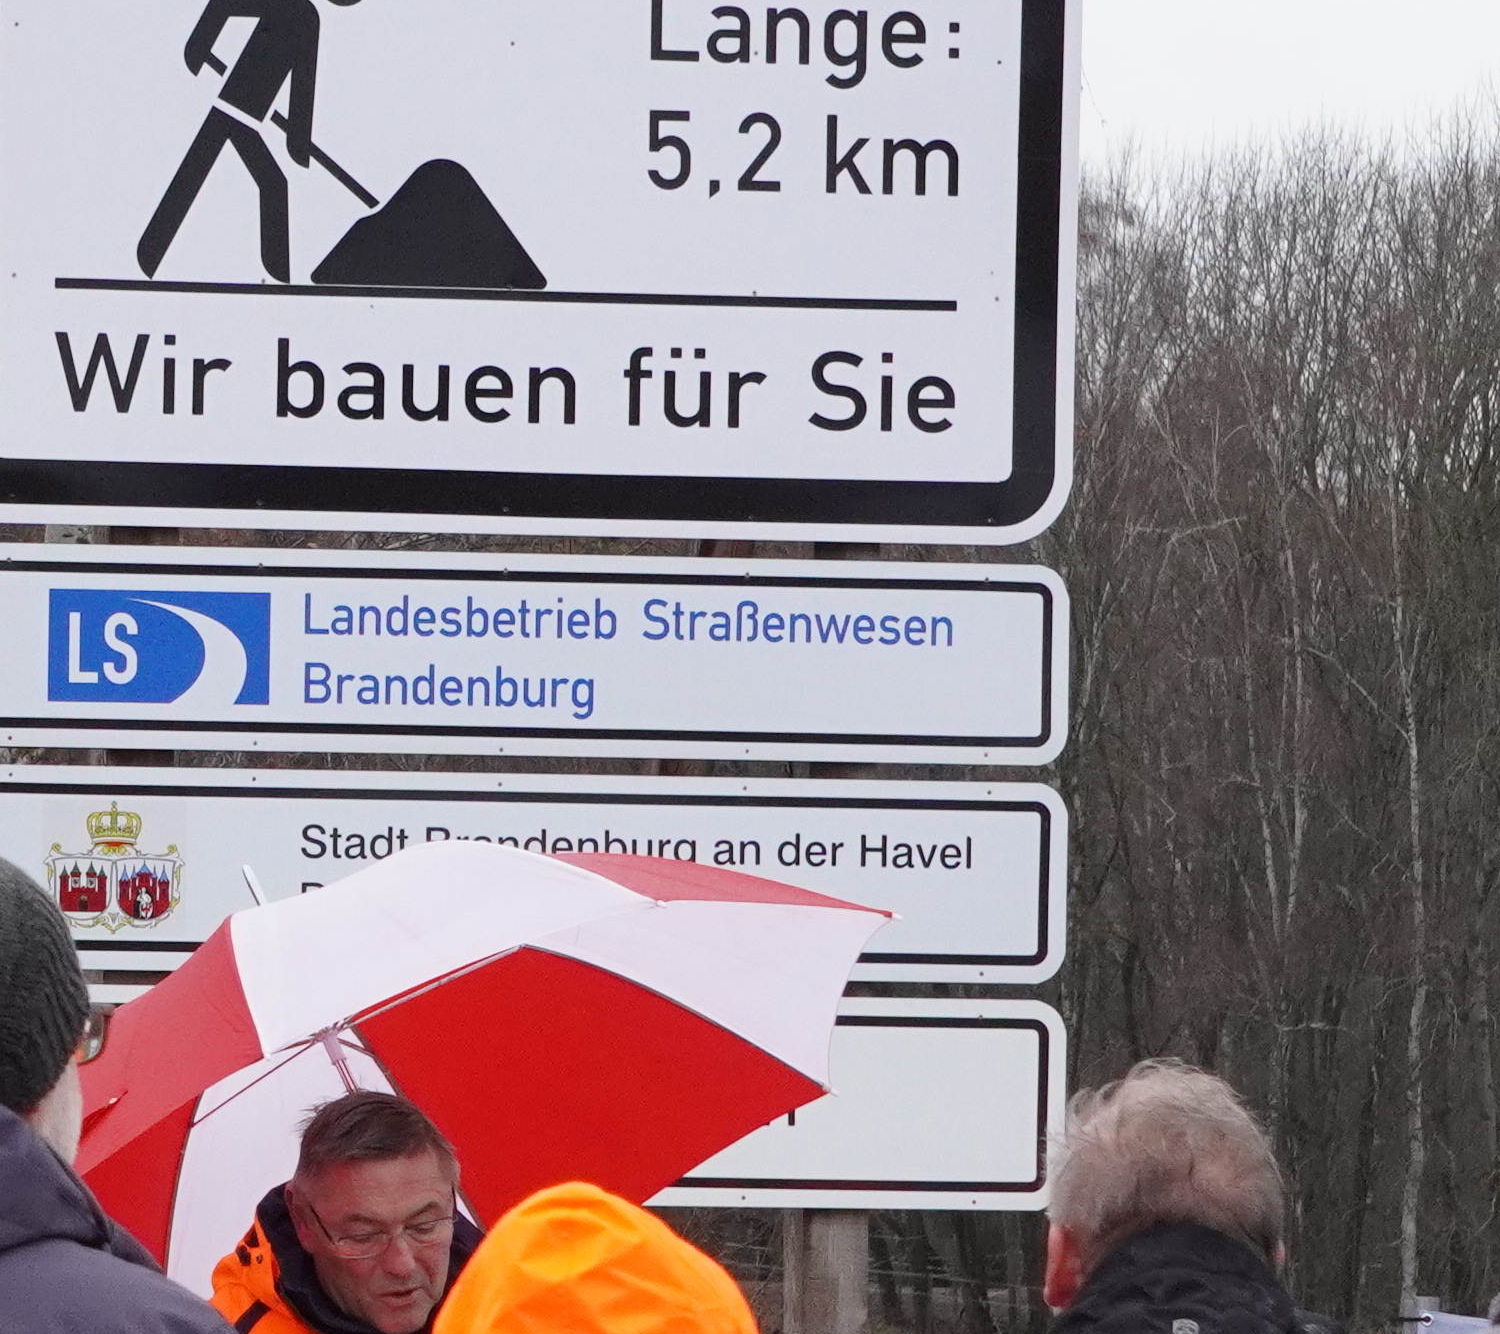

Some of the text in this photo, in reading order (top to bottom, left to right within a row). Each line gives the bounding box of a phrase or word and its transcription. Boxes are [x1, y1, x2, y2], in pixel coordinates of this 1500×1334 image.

[647, 109, 959, 199] 5,2 km
[54, 331, 956, 434] Wir bauen für Sie
[68, 611, 139, 685] LS
[304, 592, 953, 647] Landesbetrieb Straßenwesen
[303, 661, 595, 720] Brandenburg
[300, 823, 409, 861] Stadt
[713, 839, 761, 866] an
[777, 832, 845, 867] der
[860, 834, 972, 870] Havel
